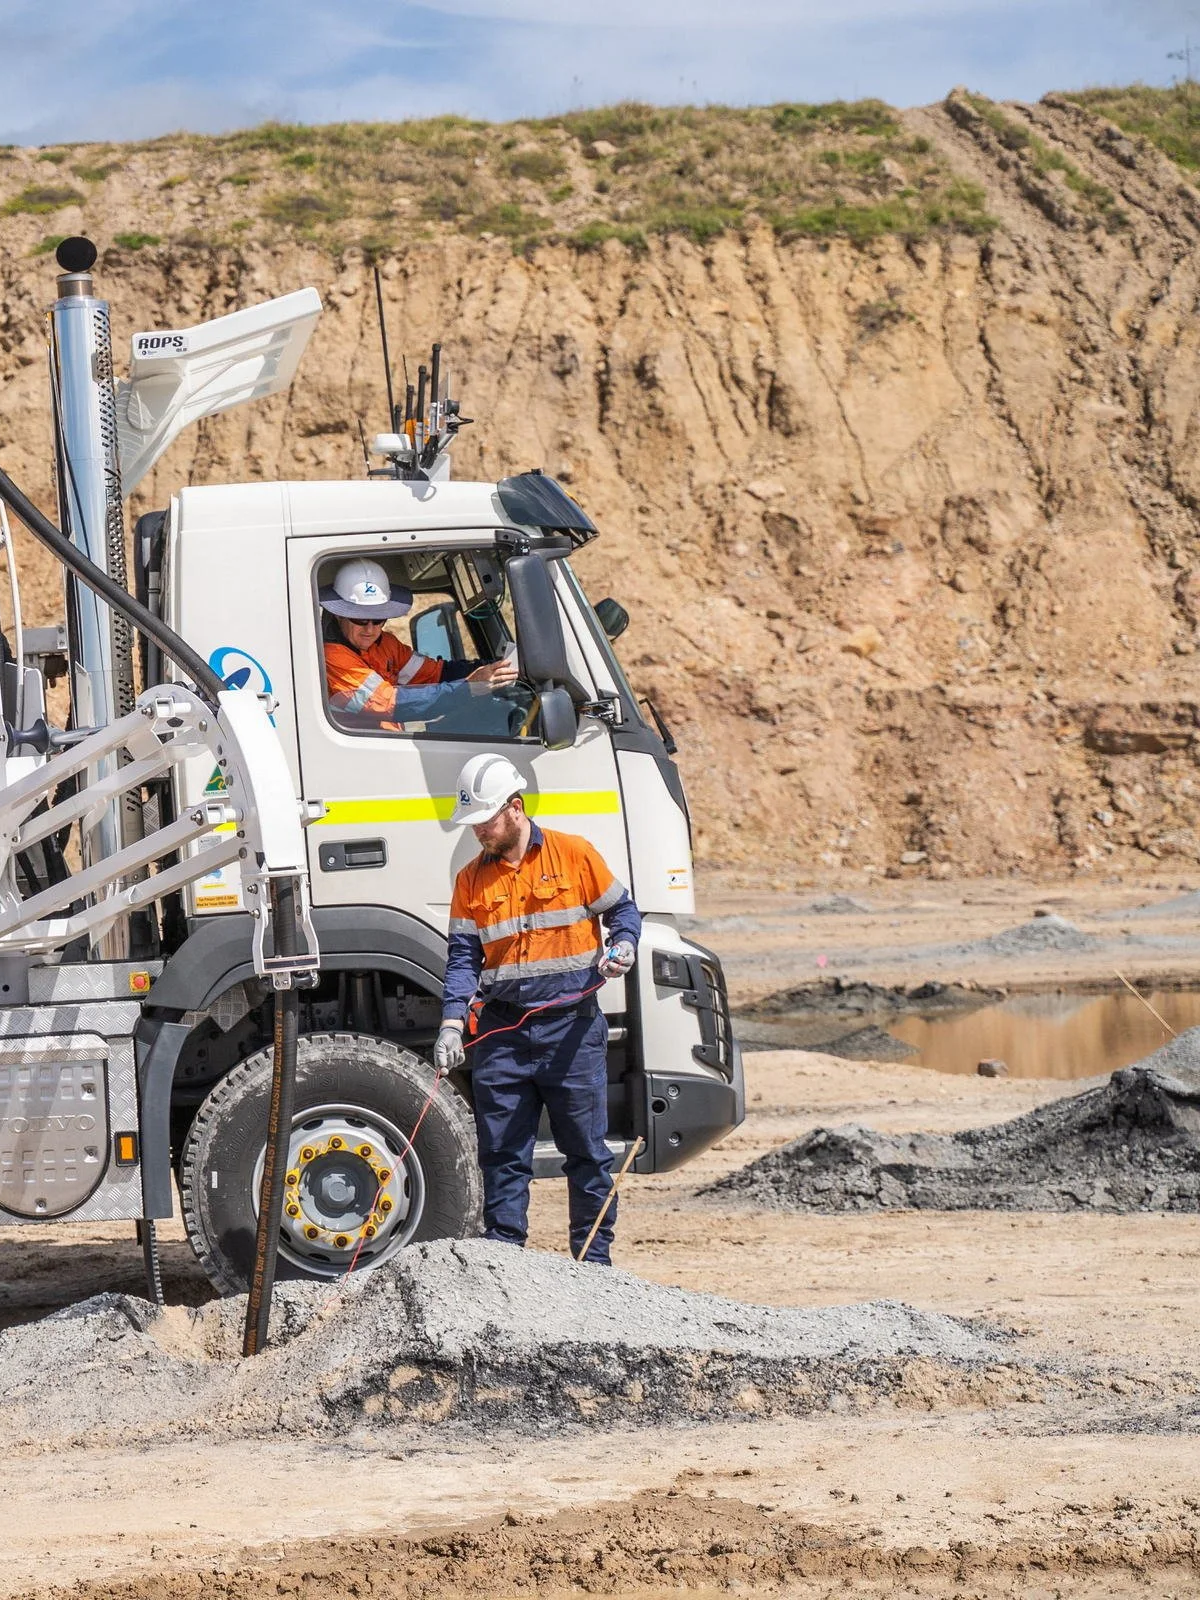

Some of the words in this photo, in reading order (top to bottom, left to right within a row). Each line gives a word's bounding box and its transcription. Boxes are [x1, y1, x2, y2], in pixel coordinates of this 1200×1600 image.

[138, 335, 184, 349] ROPS
[274, 1023, 283, 1073] DELIVERY
[269, 1076, 281, 1134] EXPLOSIVE
[264, 1144, 276, 1177] BLAST
[261, 1179, 272, 1212] NITRO
[256, 1256, 265, 1273] bar
